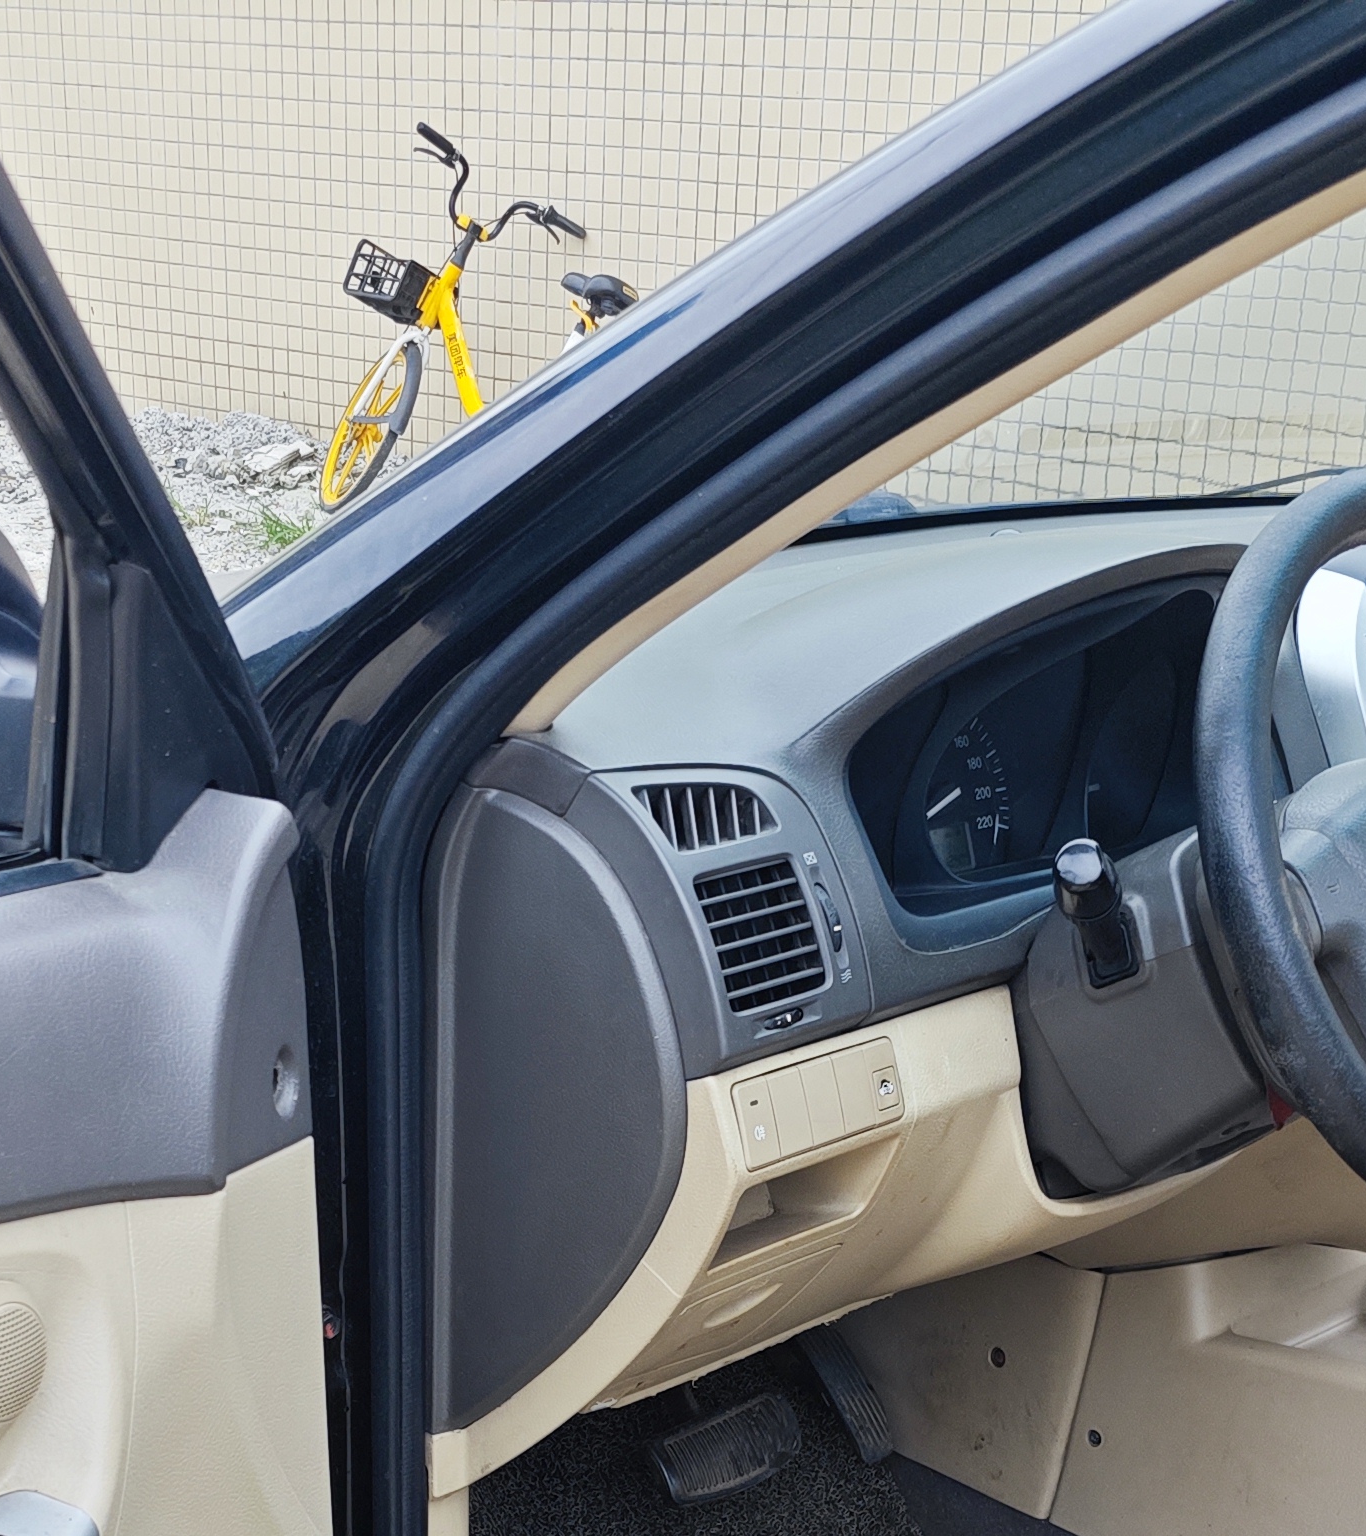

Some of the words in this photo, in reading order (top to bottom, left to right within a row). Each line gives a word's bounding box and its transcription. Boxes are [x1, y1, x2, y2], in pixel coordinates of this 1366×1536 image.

[446, 332, 467, 379] 美团单车
[954, 735, 969, 748] 160
[967, 757, 983, 769] 180
[975, 786, 992, 800] 200
[976, 815, 994, 829] 220
